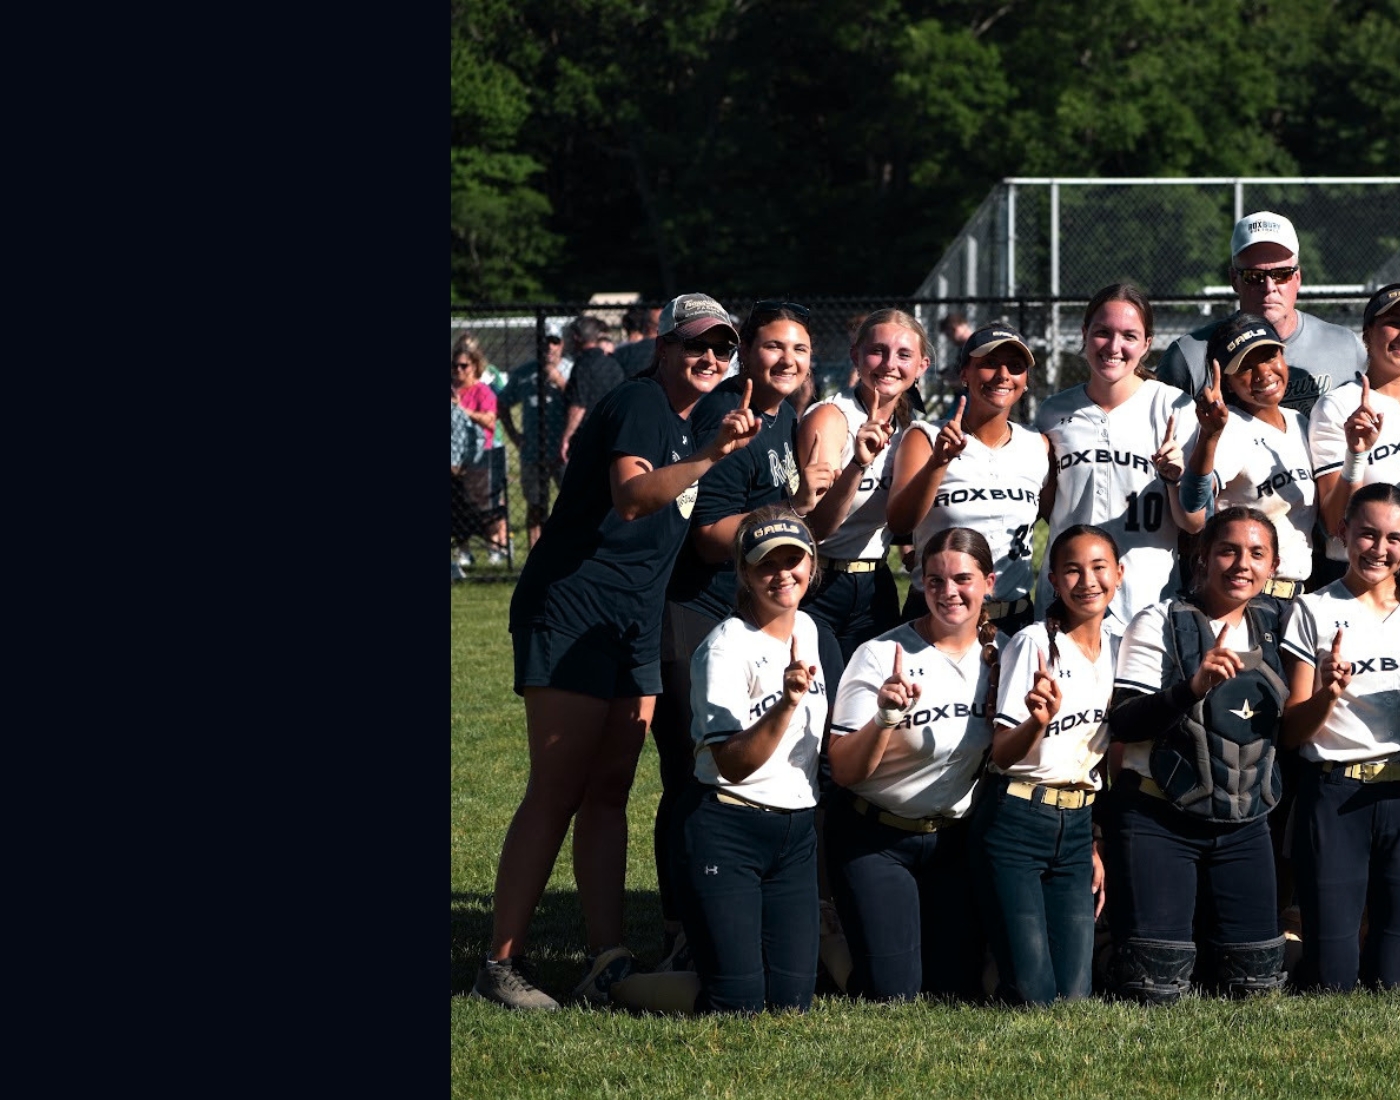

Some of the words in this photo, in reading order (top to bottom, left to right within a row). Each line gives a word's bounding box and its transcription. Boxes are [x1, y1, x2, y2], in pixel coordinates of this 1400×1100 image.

[1248, 221, 1281, 231] ROXBURY
[1226, 328, 1267, 352] GAELS
[934, 488, 1040, 507] ROXBUR
[1124, 491, 1163, 532] 10
[754, 523, 800, 539] GAELS
[895, 703, 986, 730] ROXBU
[1043, 709, 1107, 738] ROXB
